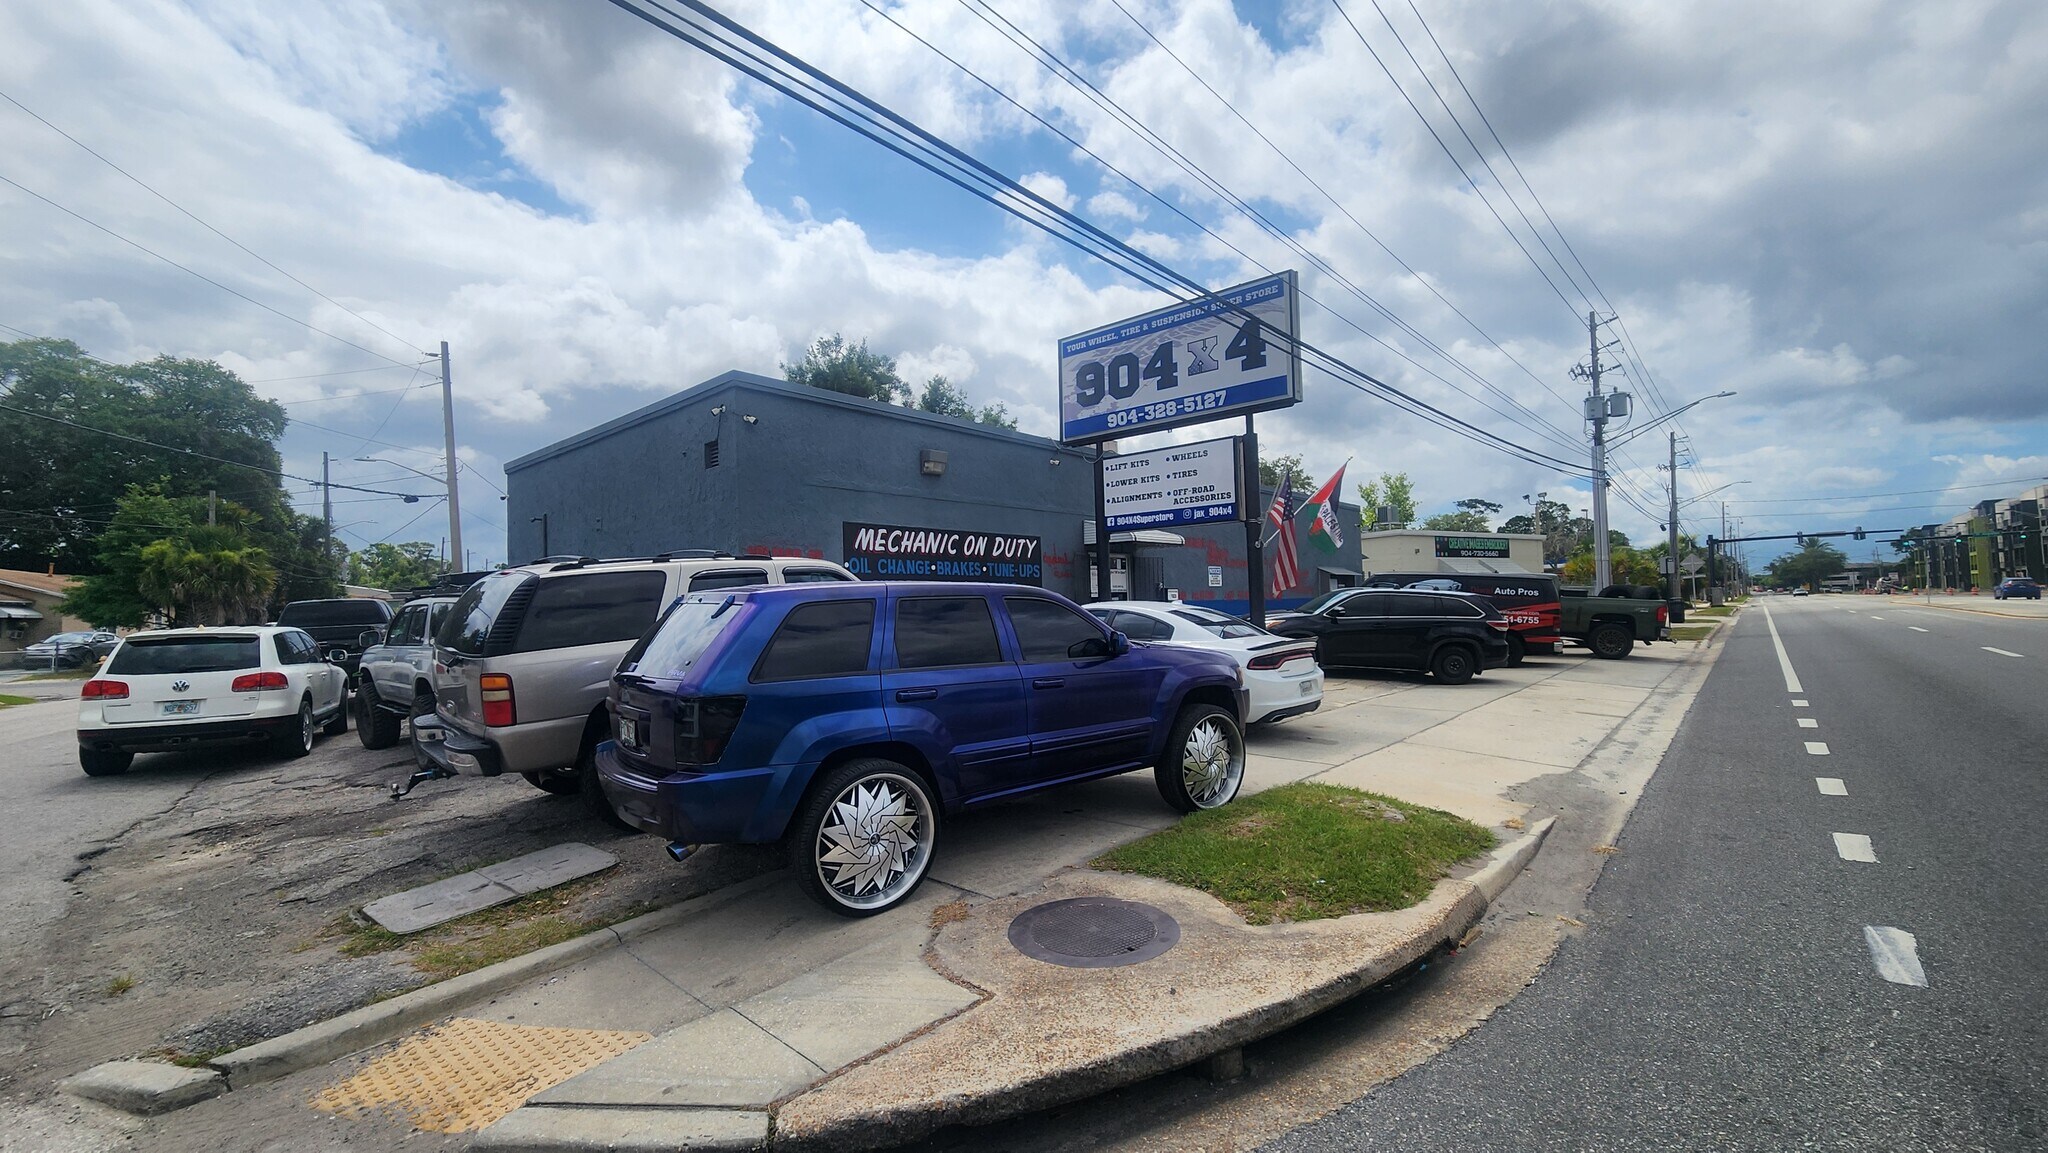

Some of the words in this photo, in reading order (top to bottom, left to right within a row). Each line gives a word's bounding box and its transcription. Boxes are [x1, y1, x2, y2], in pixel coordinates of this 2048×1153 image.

[1066, 342, 1086, 352] YOUR
[1088, 332, 1118, 346] WHEEL,
[1120, 326, 1140, 337] TIRE
[1211, 296, 1242, 311] SER
[1246, 284, 1278, 300] STORE
[1107, 390, 1227, 428] 904-328-5127
[1172, 450, 1208, 462] WHEELS
[1110, 462, 1128, 471] LIFT
[1130, 460, 1150, 468] KITS
[1172, 470, 1198, 479] TIRES
[1111, 478, 1138, 487] LOWER
[1140, 475, 1160, 483] KITS
[1173, 485, 1215, 496] OFF-ROAD
[1111, 492, 1163, 504] ALIGNMENTS
[1173, 492, 1232, 505] ACCESSORIES
[1193, 506, 1232, 520] jax_904x4
[854, 527, 960, 555] MECHANIC
[963, 536, 987, 557] ON
[991, 538, 1038, 559] DUTY
[850, 557, 872, 575] OIL
[877, 558, 931, 576] CHANGE
[937, 561, 982, 577] BRAKES
[986, 562, 1040, 578] TUNE-UPS
[1494, 587, 1516, 595] Auto
[1518, 588, 1539, 596] Pros
[1503, 616, 1539, 624] 51-6755
